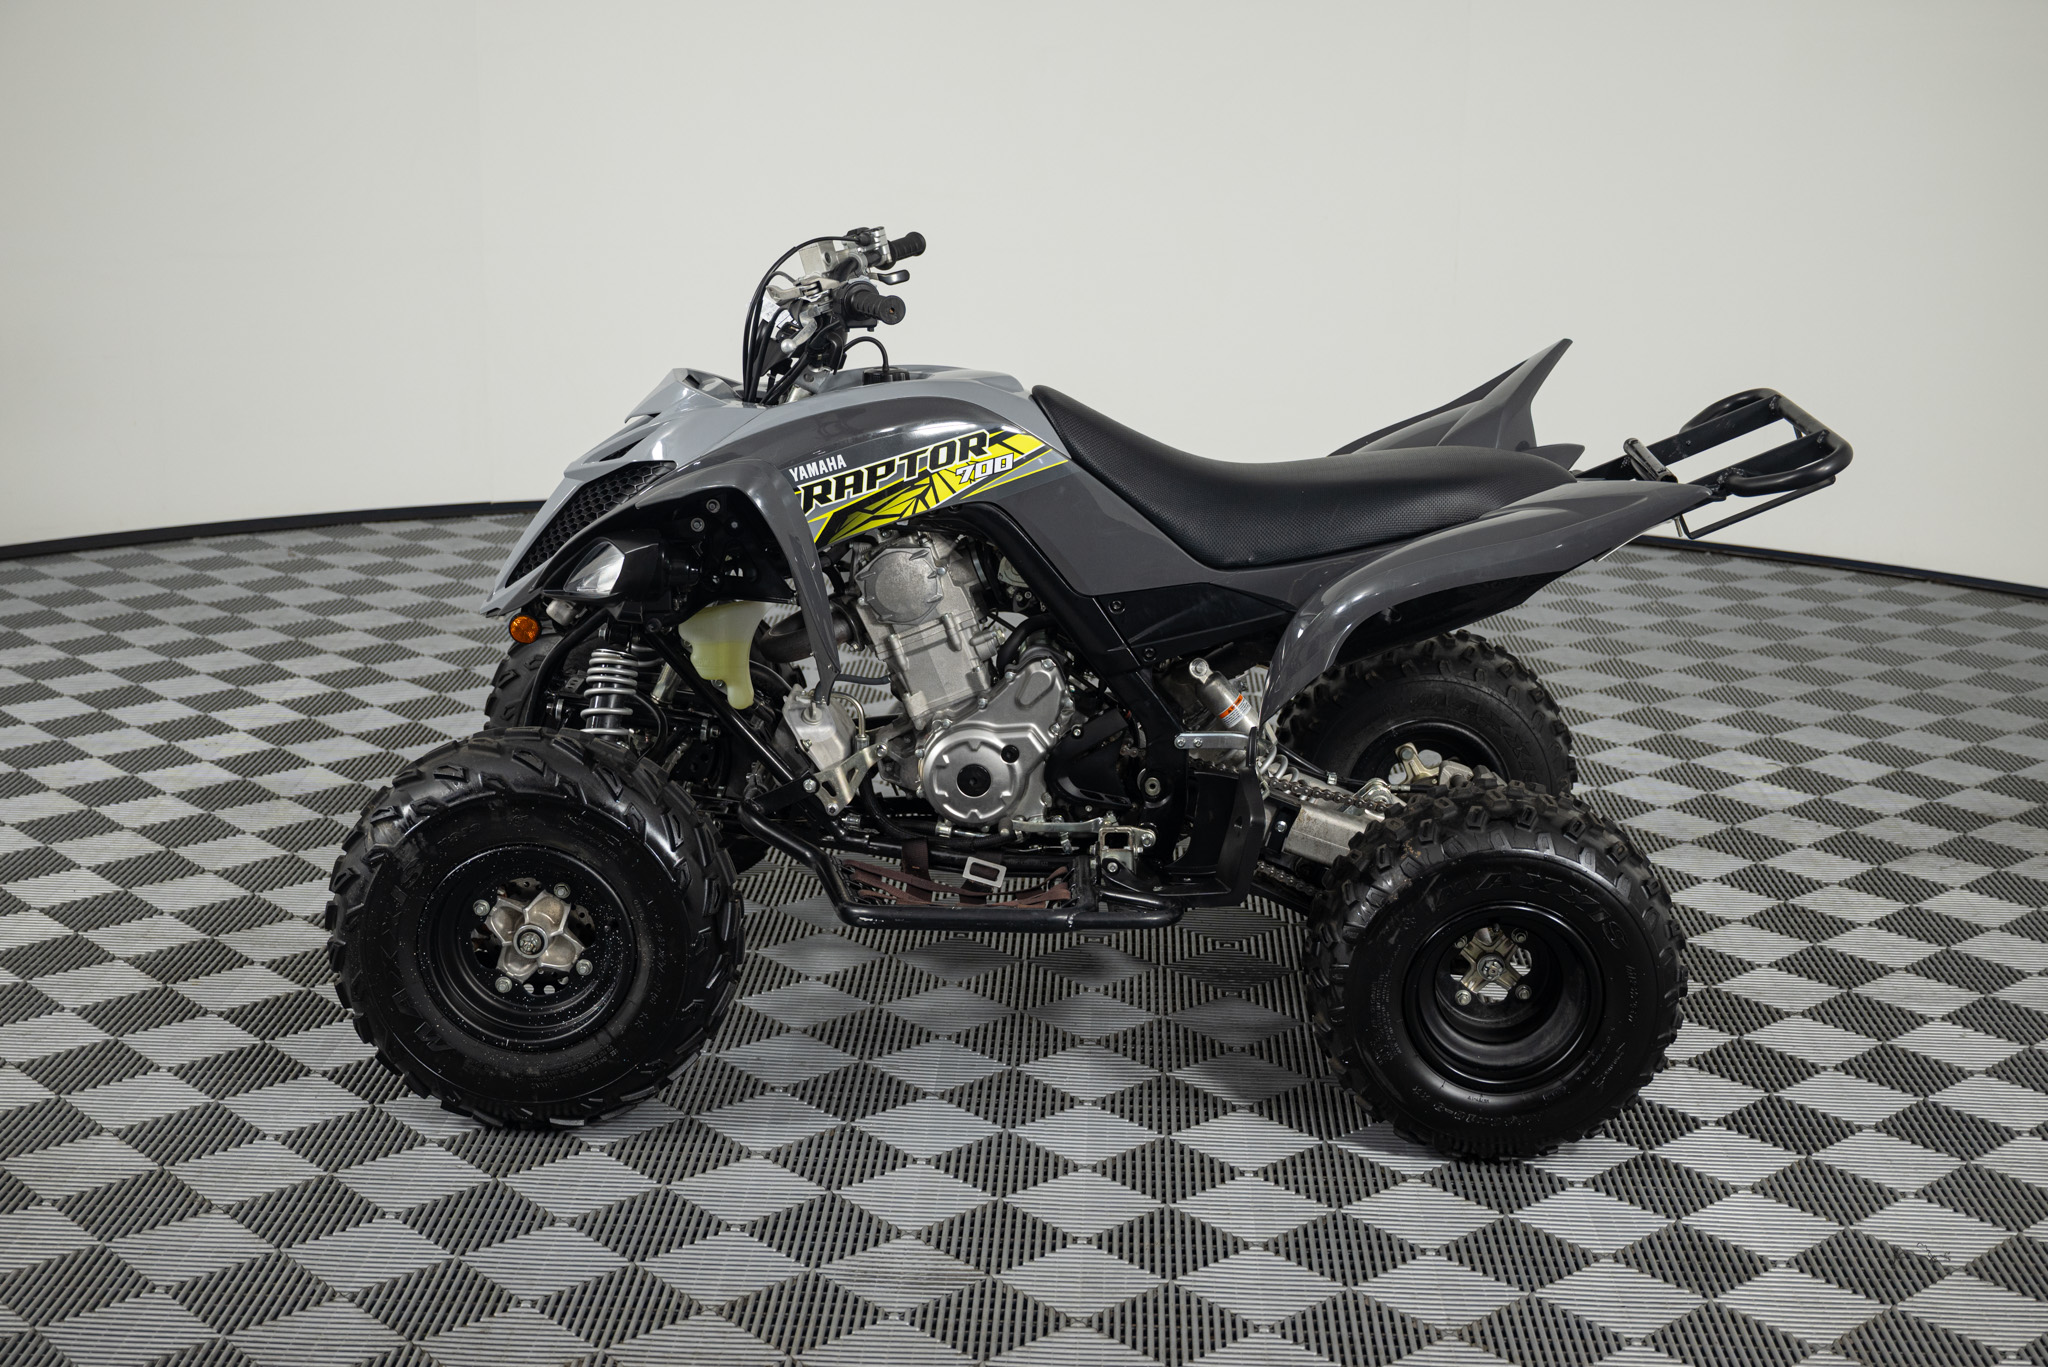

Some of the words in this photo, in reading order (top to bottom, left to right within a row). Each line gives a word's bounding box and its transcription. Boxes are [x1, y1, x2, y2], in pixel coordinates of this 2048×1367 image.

[788, 453, 847, 482] YAMAHA
[798, 429, 992, 516] RAPTOR
[956, 453, 1014, 484] 700
[1424, 871, 1630, 950] MAXXIS
